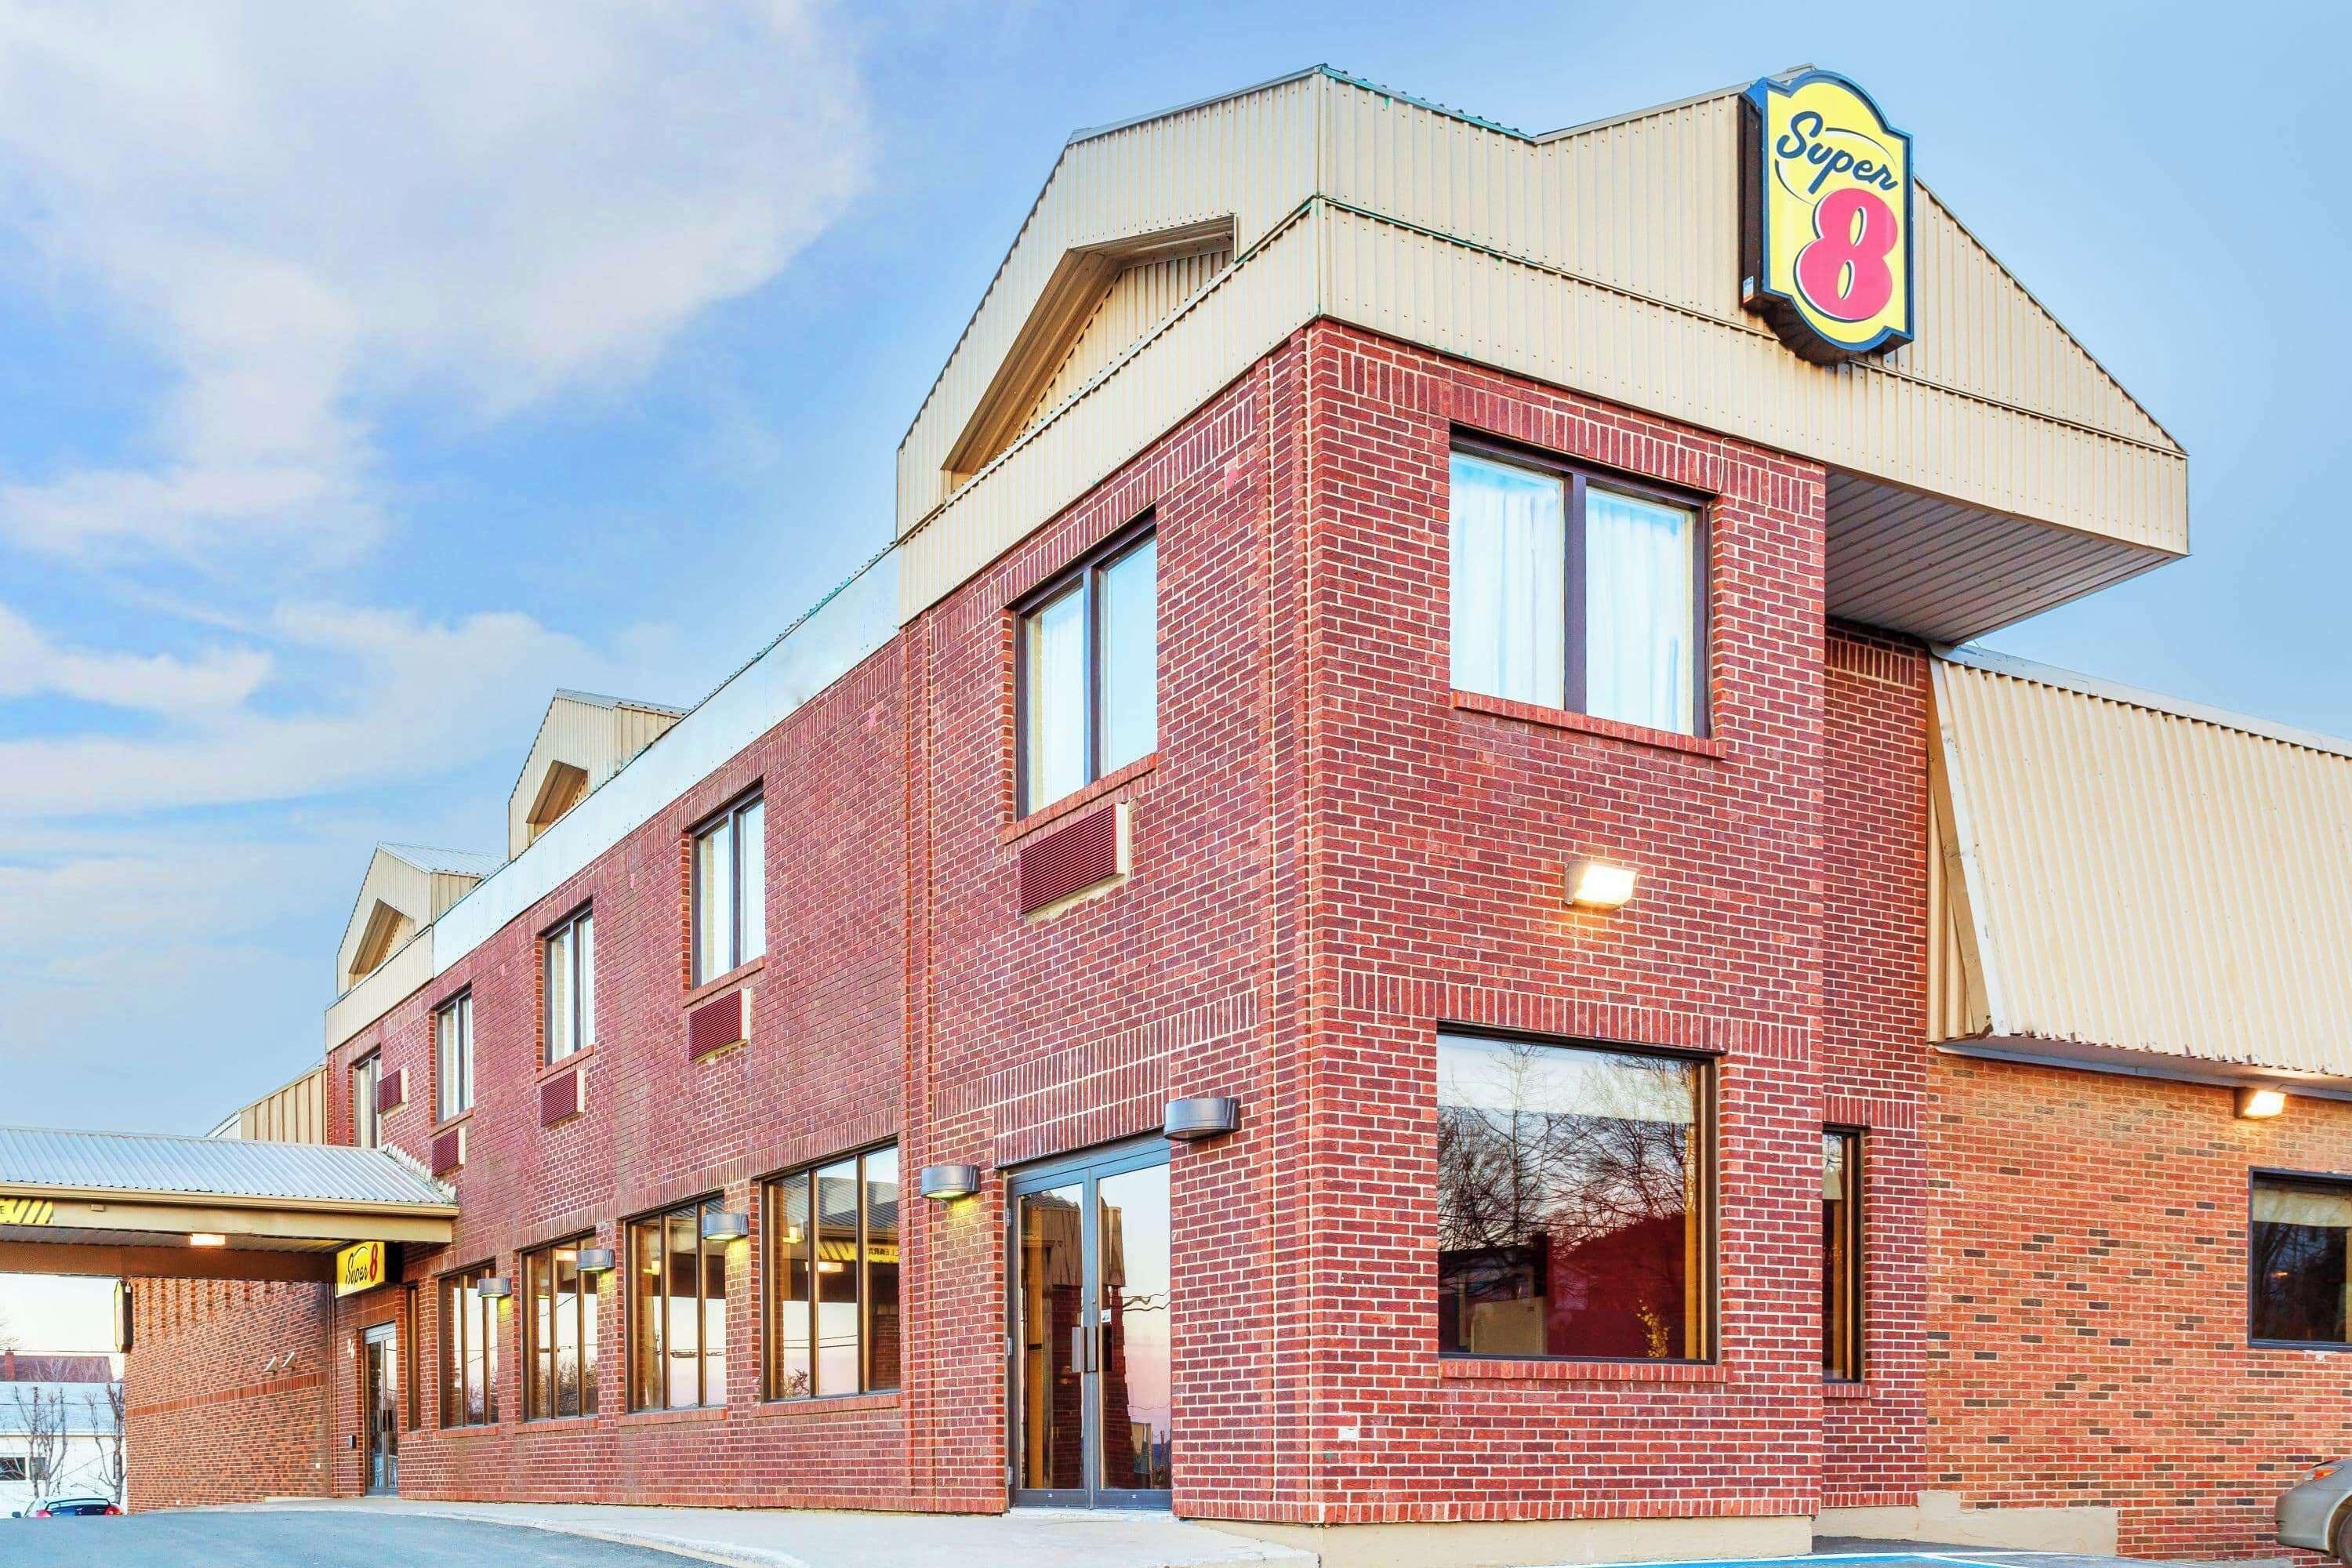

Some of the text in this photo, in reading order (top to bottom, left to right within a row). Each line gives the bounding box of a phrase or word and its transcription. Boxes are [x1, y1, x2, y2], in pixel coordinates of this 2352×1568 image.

[1777, 111, 1898, 194] Super
[1794, 188, 1897, 322] 8
[346, 1243, 378, 1287] Super 8
